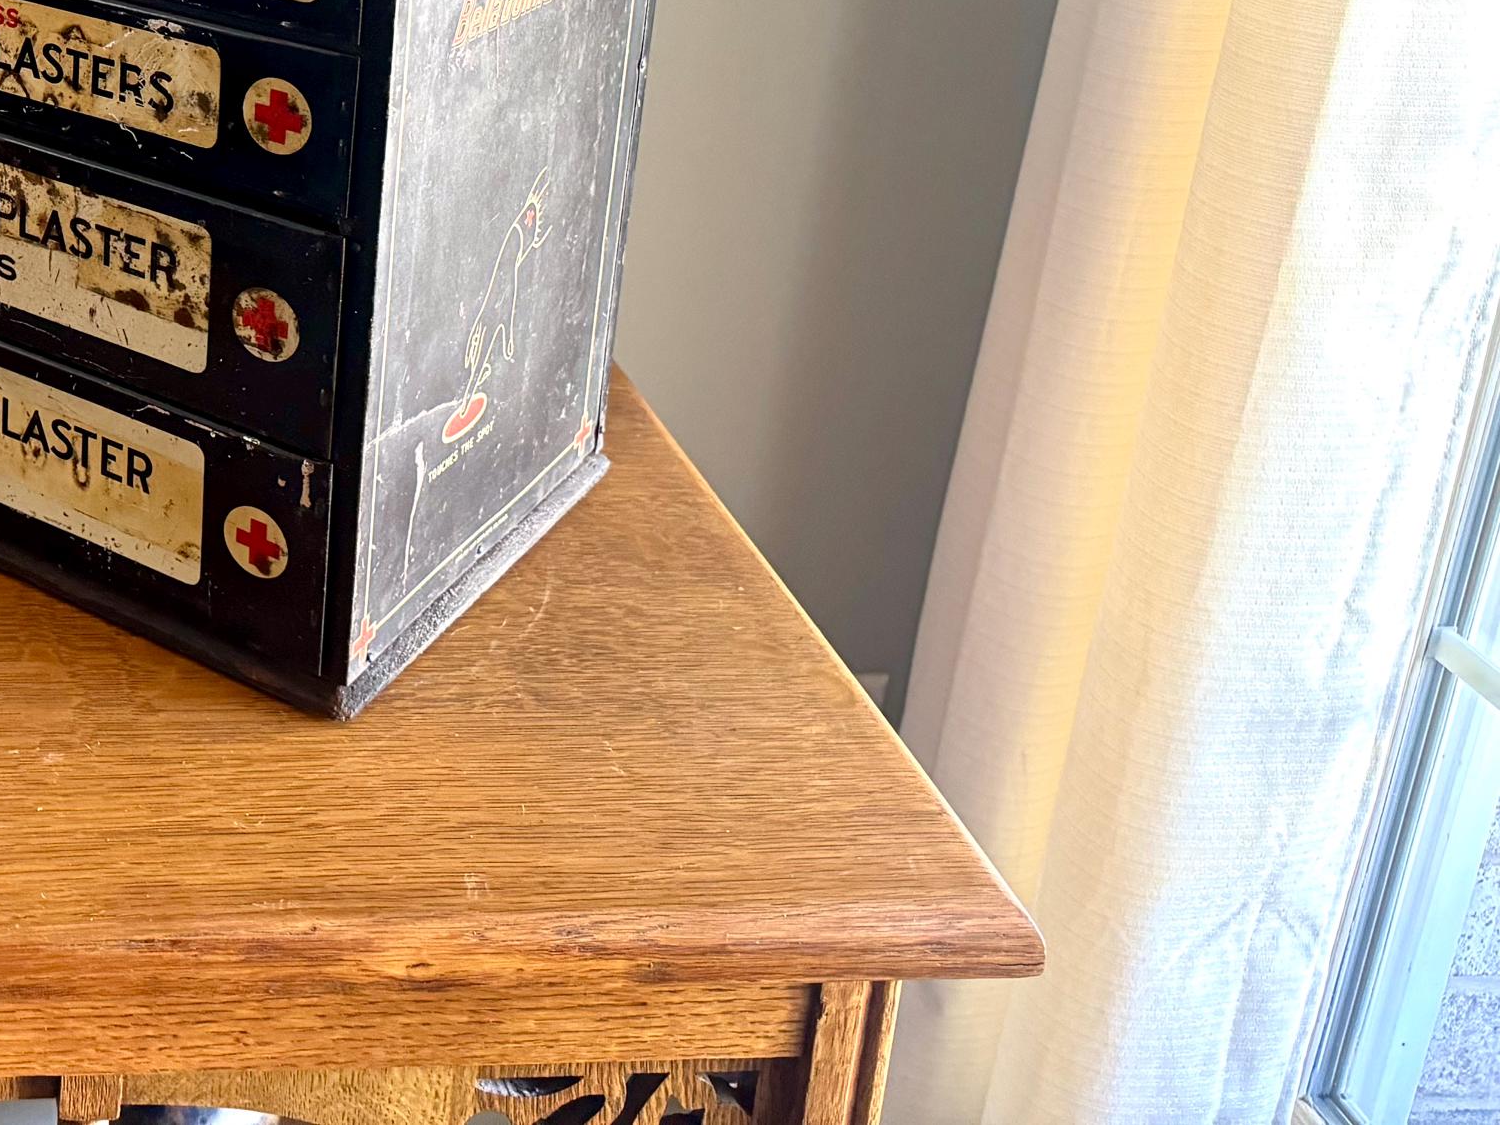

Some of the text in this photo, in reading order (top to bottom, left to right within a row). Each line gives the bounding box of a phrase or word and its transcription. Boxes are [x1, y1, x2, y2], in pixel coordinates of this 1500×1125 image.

[428, 419, 495, 483] TOUCHES THE SPOT
